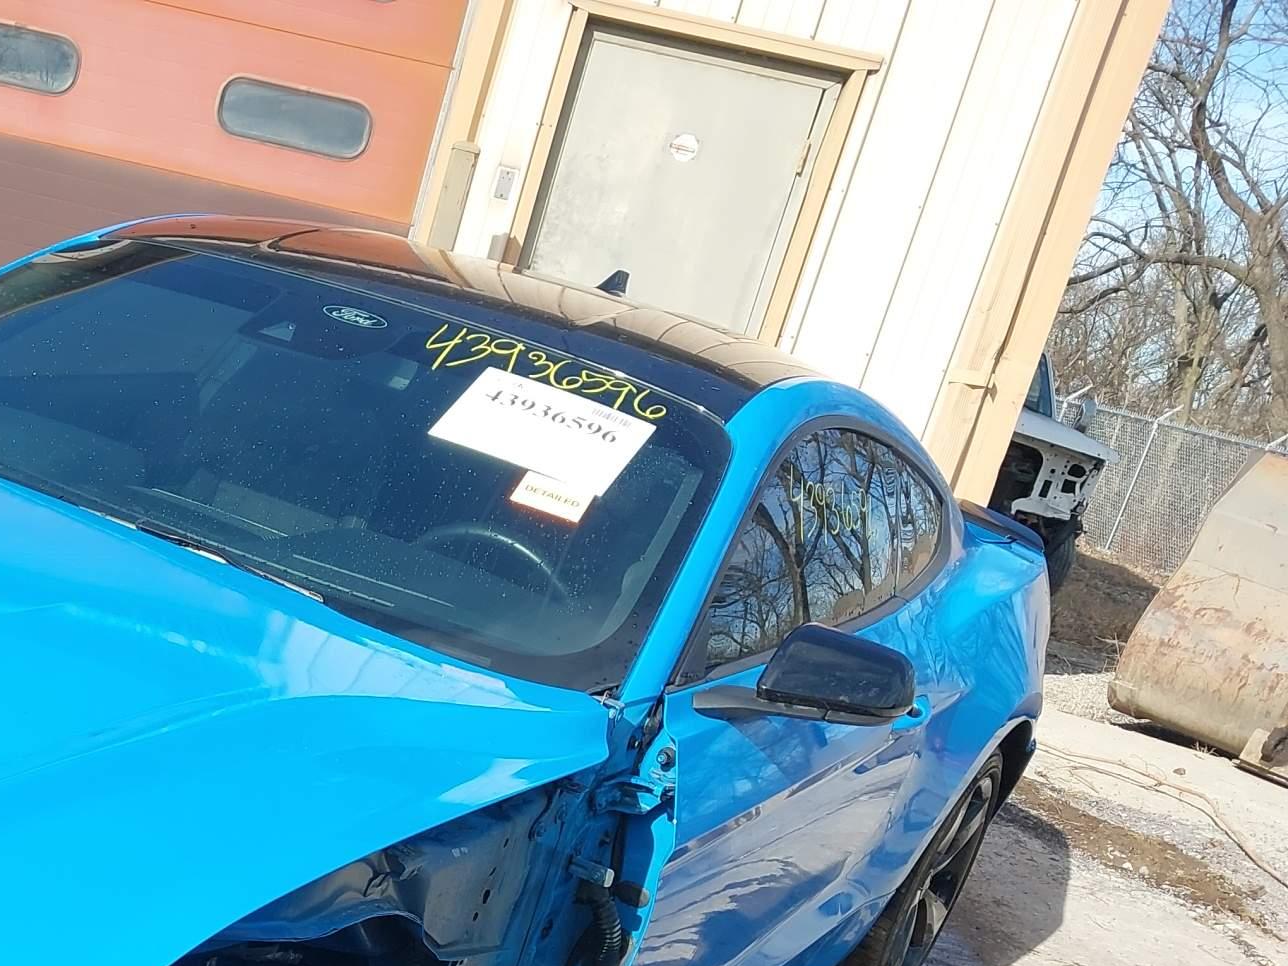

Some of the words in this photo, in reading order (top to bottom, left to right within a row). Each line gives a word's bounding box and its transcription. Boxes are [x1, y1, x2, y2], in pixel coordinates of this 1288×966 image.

[330, 307, 379, 326] Ford
[425, 324, 667, 421] 43936596
[485, 390, 617, 443] 43936596
[524, 484, 581, 508] DETAILED
